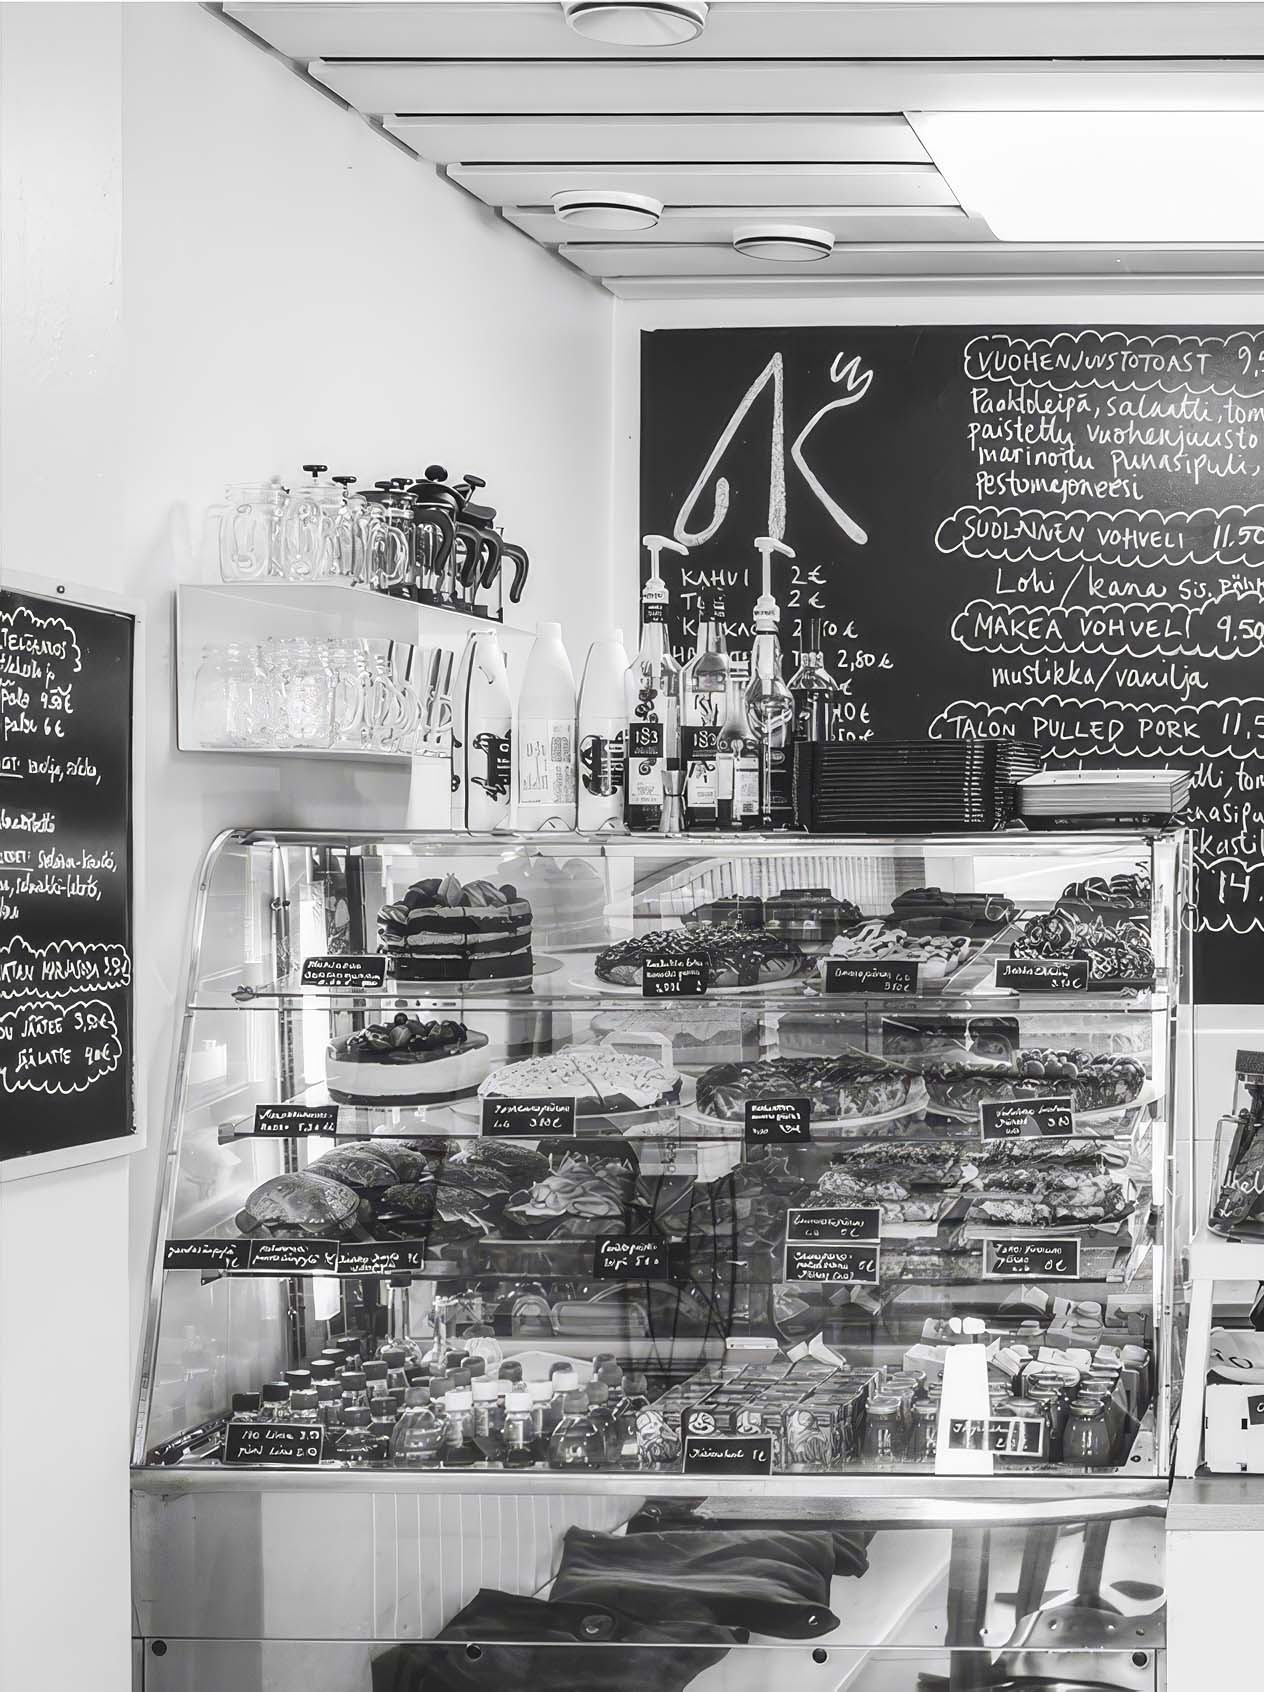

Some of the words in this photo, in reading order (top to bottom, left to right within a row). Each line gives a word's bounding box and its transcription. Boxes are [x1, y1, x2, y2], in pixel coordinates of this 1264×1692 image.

[967, 419, 1073, 450] paistettu
[979, 447, 1094, 469] marinoitu
[1099, 529, 1184, 551] VOHVELI
[680, 568, 748, 587] KAHVI
[975, 612, 1063, 640] MAKEA
[1081, 612, 1193, 639] VOHVELI
[946, 715, 1016, 739] TALON
[1033, 717, 1124, 741] PULLED
[1139, 718, 1200, 739] PORK
